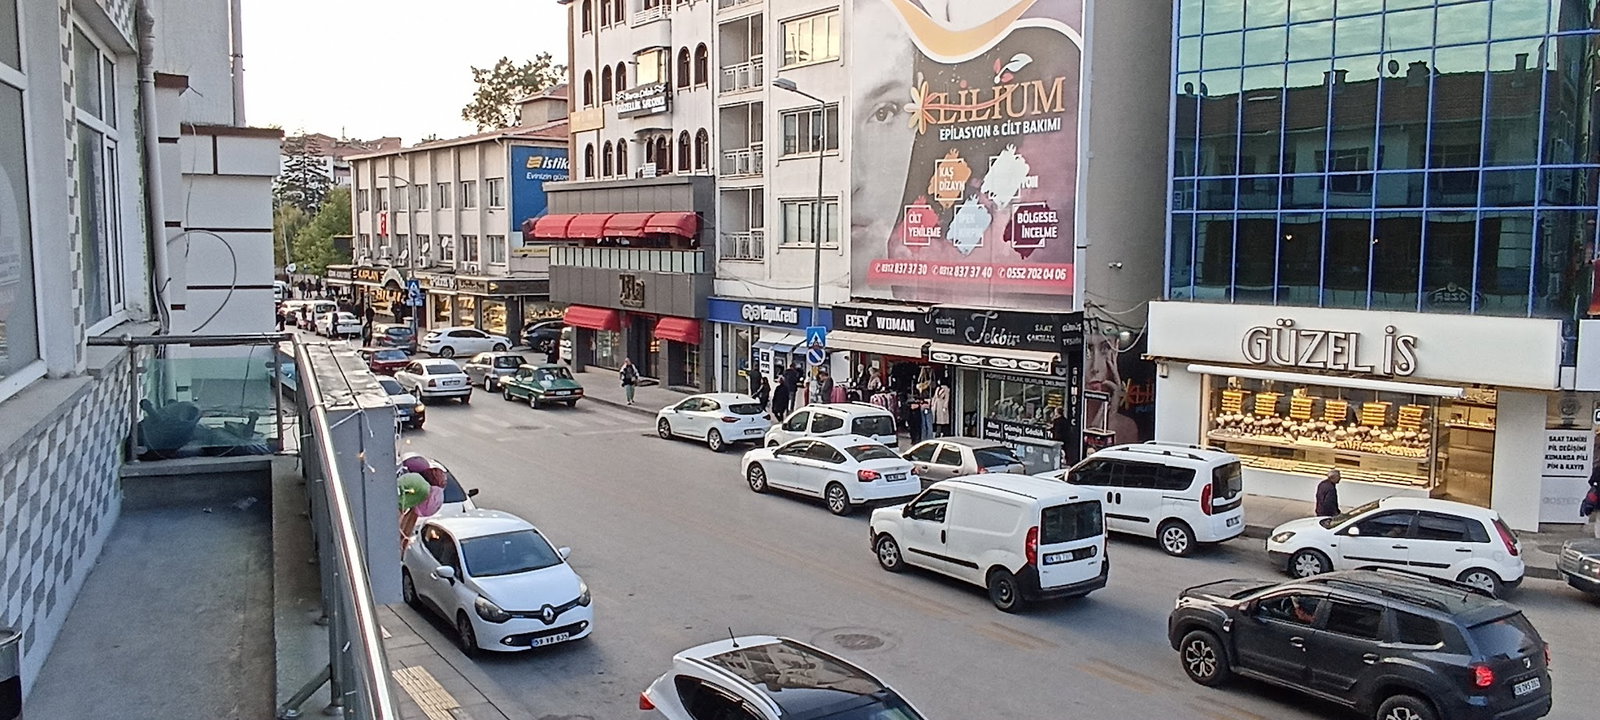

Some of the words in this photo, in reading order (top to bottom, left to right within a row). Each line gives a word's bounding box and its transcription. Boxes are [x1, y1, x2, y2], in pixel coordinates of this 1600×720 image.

[940, 125, 990, 141] EPİLASYON
[994, 127, 999, 136] &
[1002, 120, 1021, 136] CİLT
[1023, 118, 1061, 134] BAKIMI
[526, 172, 552, 180] Evinizin
[940, 167, 954, 180] KAŞ
[939, 180, 965, 191] DİZAYN
[909, 214, 922, 224] CİLT
[1017, 211, 1058, 223] BÖLGESEL
[909, 227, 941, 238] YENİLEME
[1022, 226, 1058, 239] İNCELME
[881, 263, 894, 273] 0312
[895, 263, 907, 274] 837
[907, 264, 917, 274] 37
[917, 264, 927, 275] 30
[939, 266, 953, 276] 0312
[954, 266, 969, 277] 837
[970, 266, 980, 278] 37
[981, 267, 993, 278] 40
[1007, 268, 1026, 279] 0552
[1027, 268, 1042, 279] 702
[1043, 269, 1055, 280] 04
[1055, 269, 1067, 280] 06
[358, 270, 378, 281] KAPLAN
[760, 305, 798, 324] YapıKredi
[877, 317, 916, 332] WOMAN
[1035, 324, 1053, 332] SAAT
[1027, 334, 1055, 343] ÇAKMAK
[1242, 318, 1375, 373] GÜZEL
[1559, 444, 1586, 452] DEĞİŞİMİ
